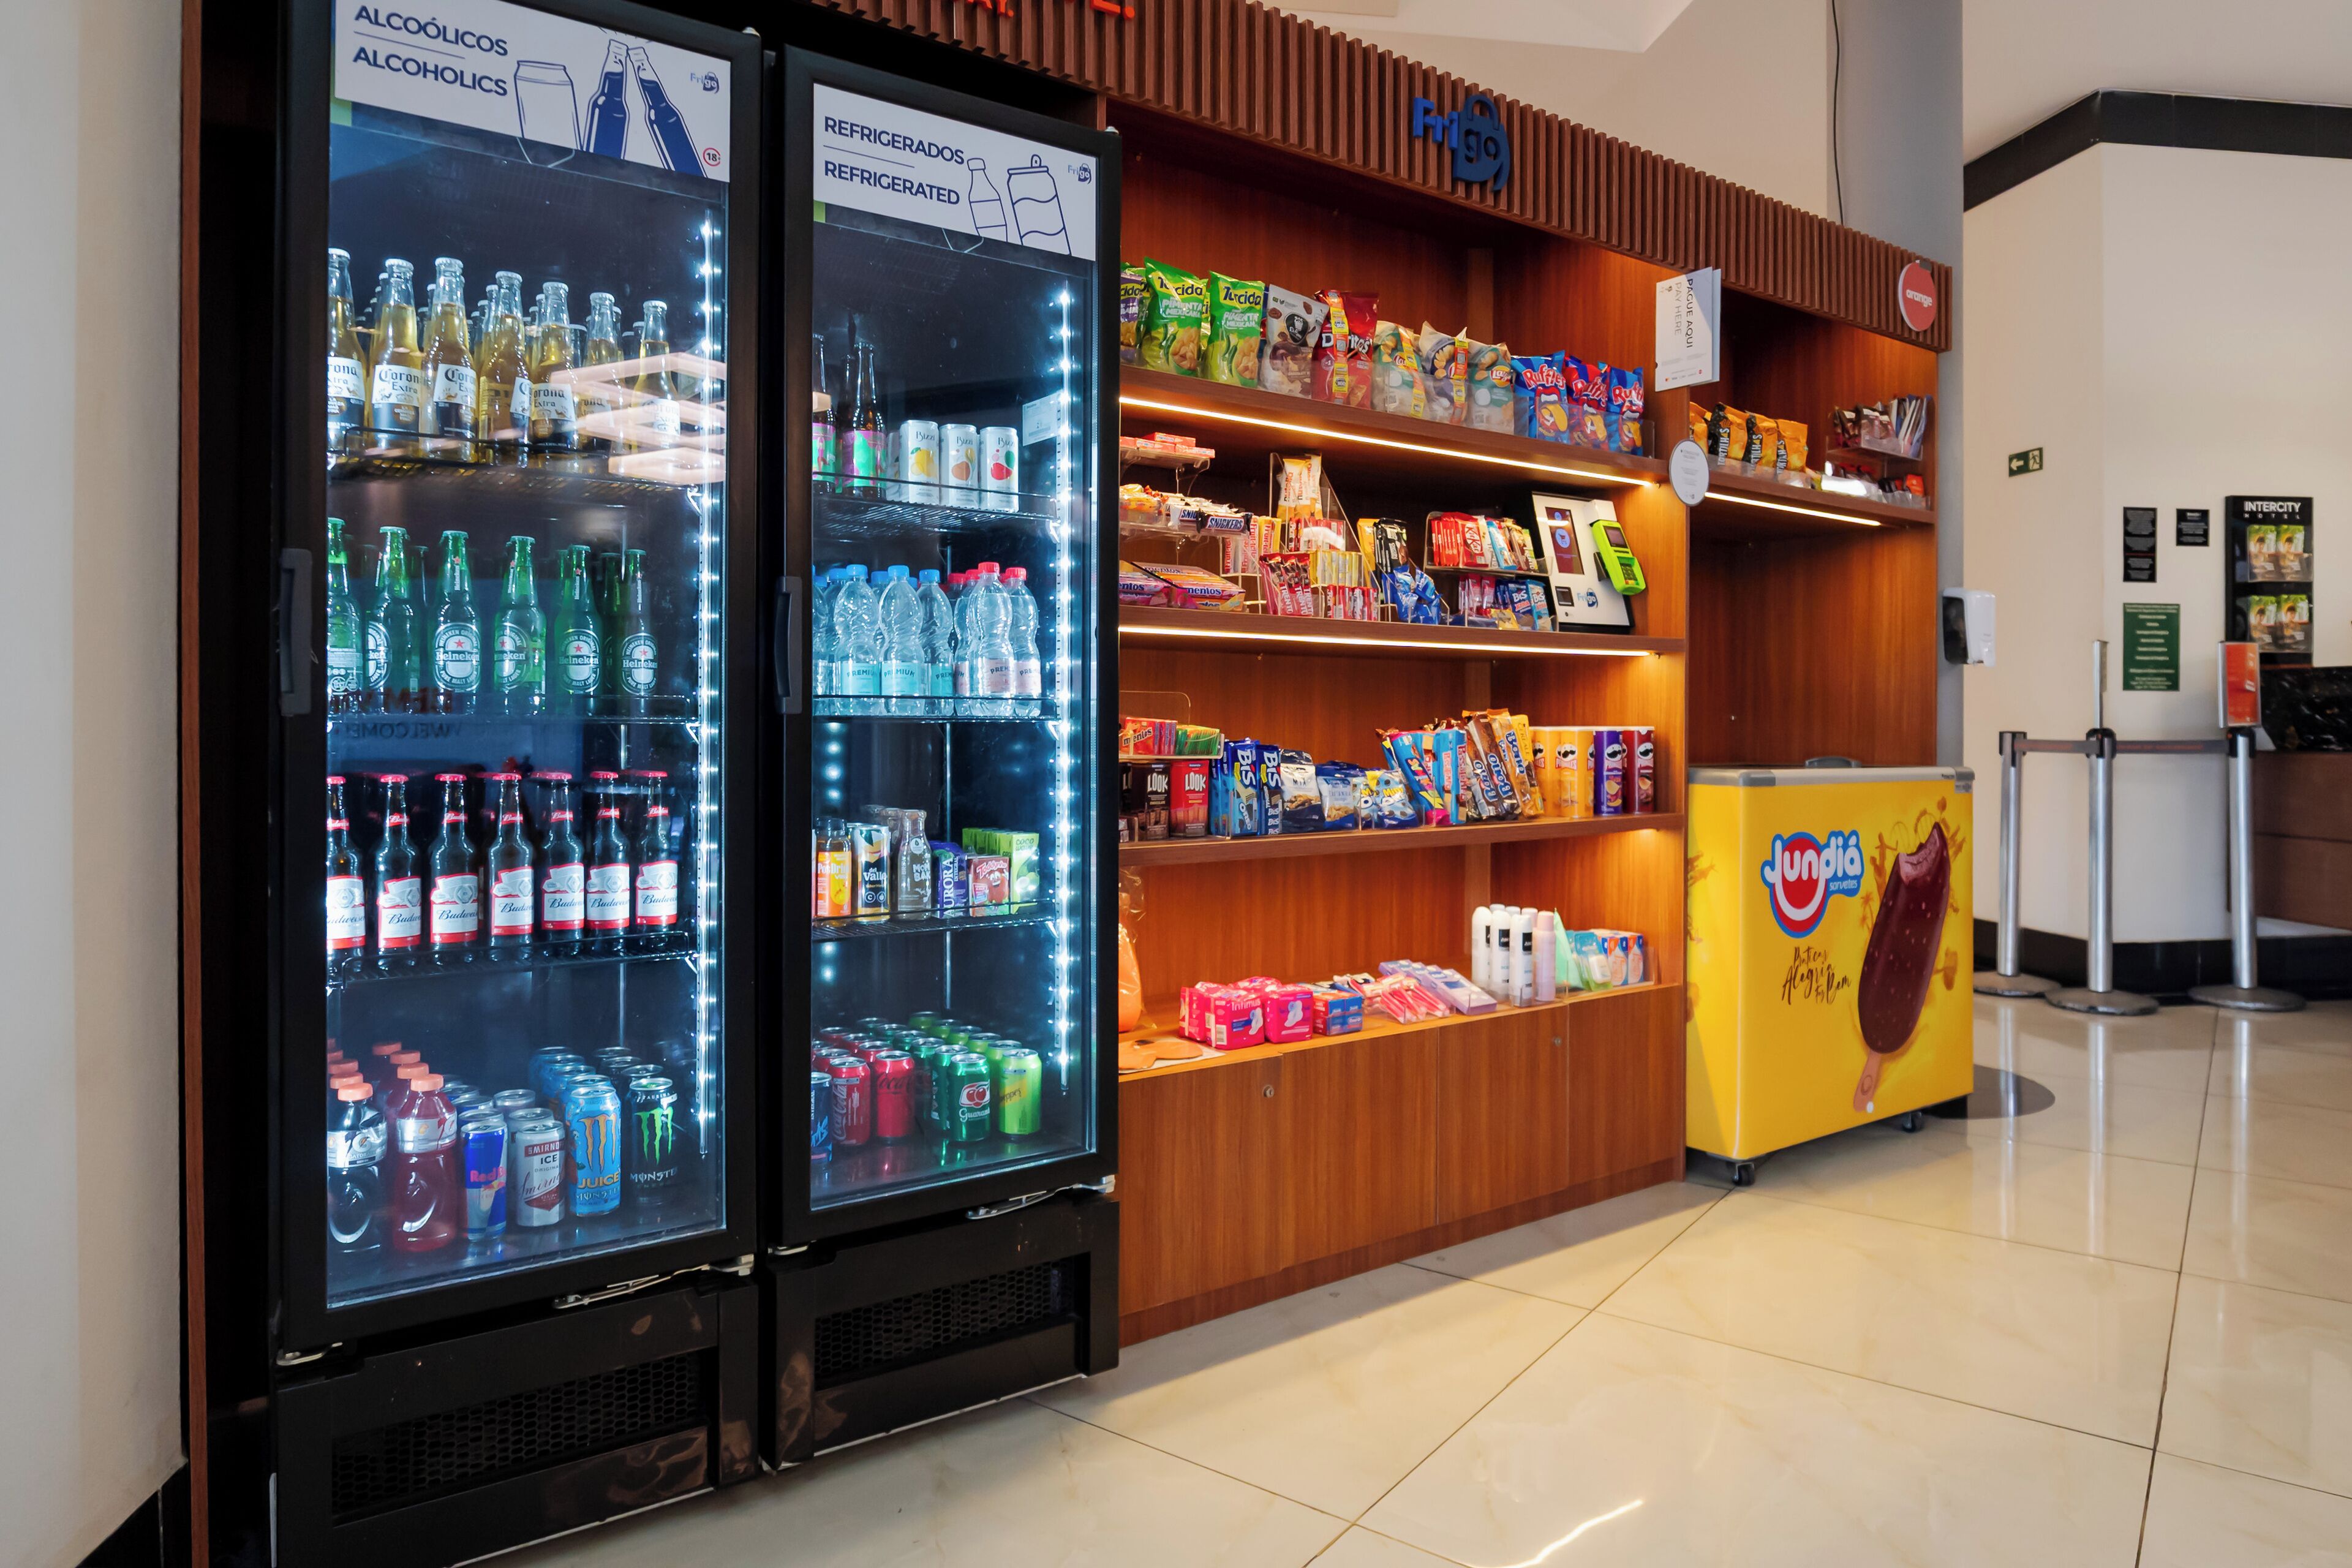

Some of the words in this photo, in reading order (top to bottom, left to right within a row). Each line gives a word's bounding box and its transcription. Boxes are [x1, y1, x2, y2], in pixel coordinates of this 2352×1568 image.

[354, 5, 508, 56] ALCOÓLICOS
[353, 46, 508, 97] ALCOHOLICS
[824, 115, 965, 165] REFRIGERADOS
[824, 160, 960, 205] REFRIGERATED
[1120, 284, 1140, 296] cida
[1158, 276, 1203, 296] Tocida
[1674, 282, 1683, 303] PAY
[1906, 289, 1932, 307] orange
[1685, 320, 1694, 349] AQUI
[328, 363, 359, 379] rona
[379, 368, 420, 383] Coron
[1522, 363, 1566, 390] Ruffles
[532, 386, 567, 399] orona
[2243, 500, 2301, 513] INTERCITY
[1208, 517, 1243, 530] SNICKERS
[1120, 581, 1145, 591] entos
[435, 651, 480, 661] Heineken
[559, 655, 599, 665] Heineken
[1506, 731, 1525, 775] Bono
[1147, 772, 1169, 793] LOOK
[1185, 772, 1206, 792] LOOK
[1239, 802, 1251, 831] OREO
[1764, 834, 1863, 894] Jundiá
[943, 859, 954, 917] AURORA
[1829, 878, 1858, 891] sorvetes
[1781, 962, 1835, 1005] Alegria
[1231, 998, 1261, 1011] Intimus
[540, 1154, 558, 1165] ICE
[470, 1168, 496, 1183] Red
[578, 1172, 620, 1189] JUICE
[630, 1167, 678, 1183] MONSTE
[576, 1186, 620, 1201] MONSTE
